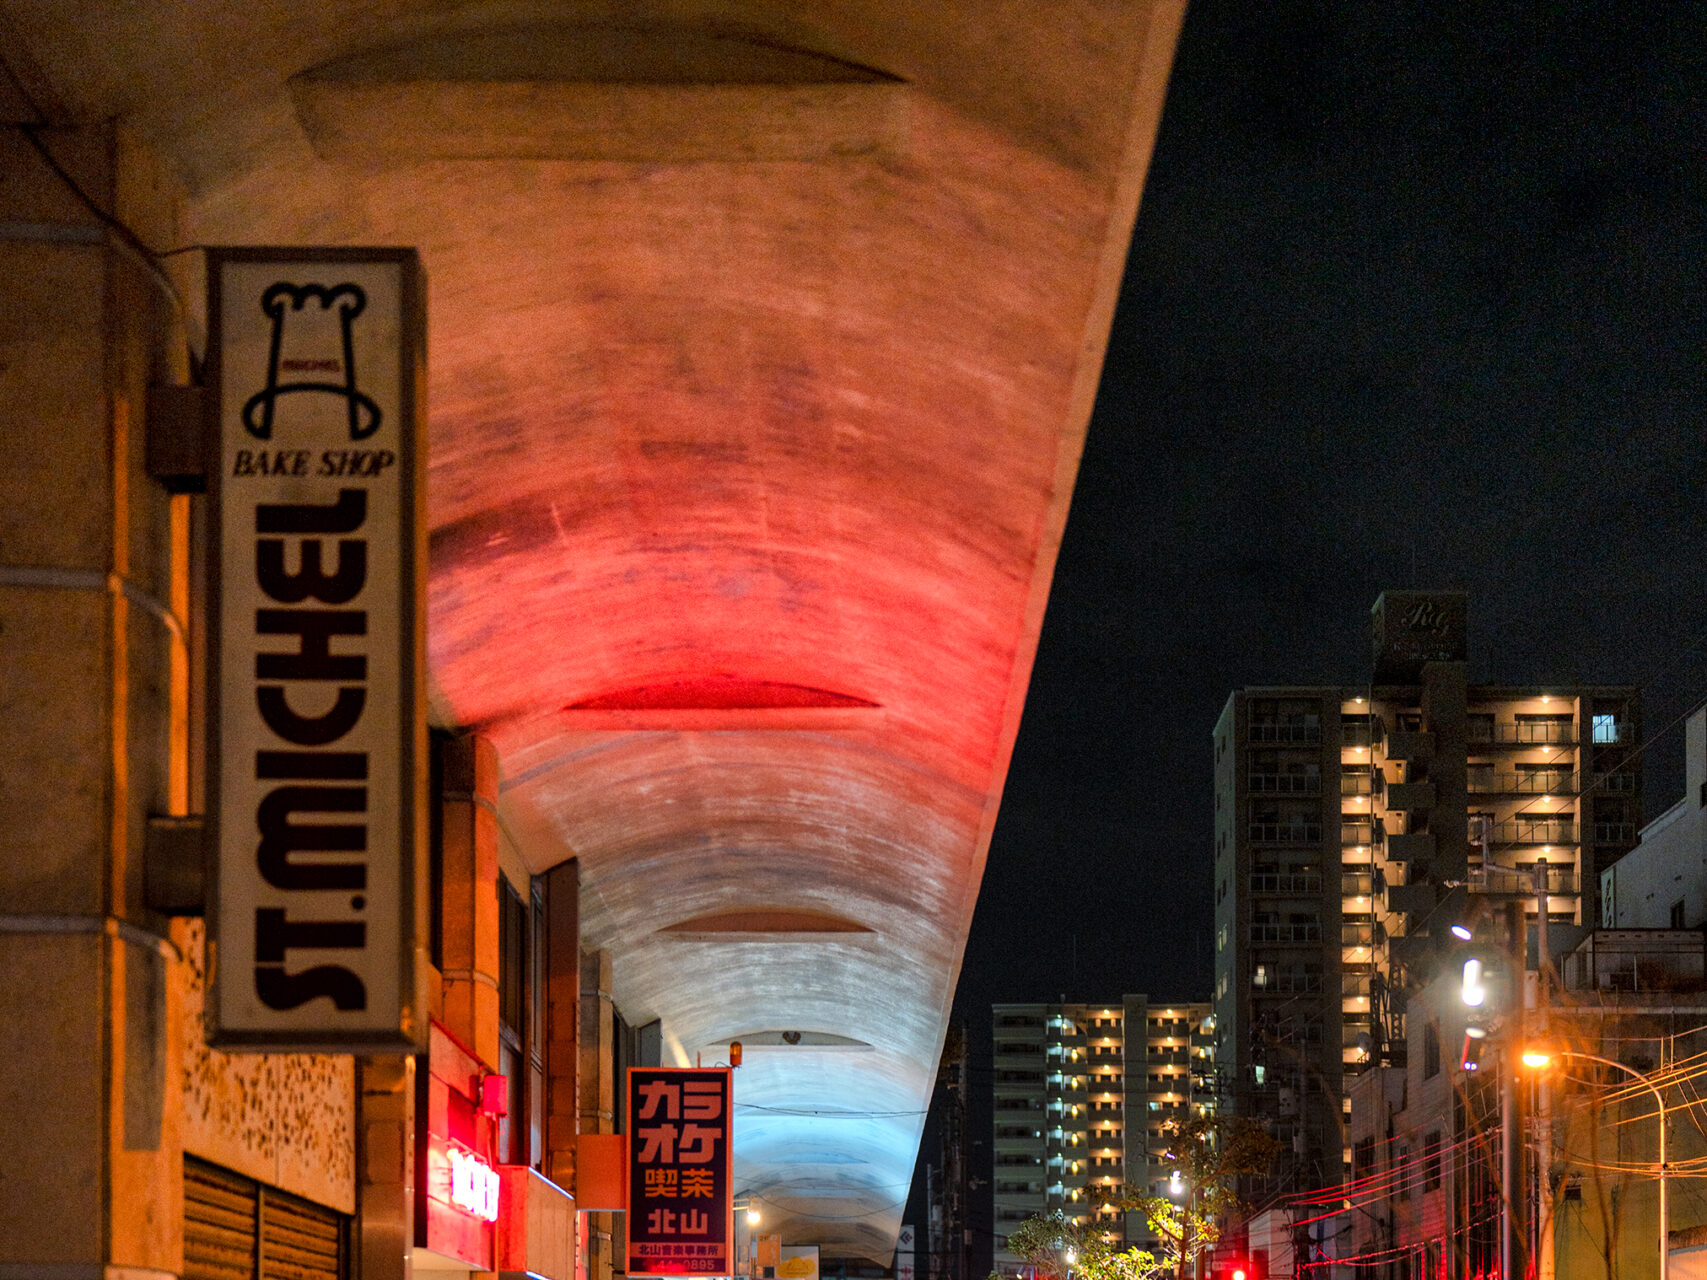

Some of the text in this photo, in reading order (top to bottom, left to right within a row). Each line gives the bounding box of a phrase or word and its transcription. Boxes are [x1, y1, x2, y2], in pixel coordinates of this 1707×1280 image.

[233, 449, 396, 476] BAKE SHOP
[645, 1168, 714, 1198] 喫茶
[648, 1208, 708, 1235] 北山
